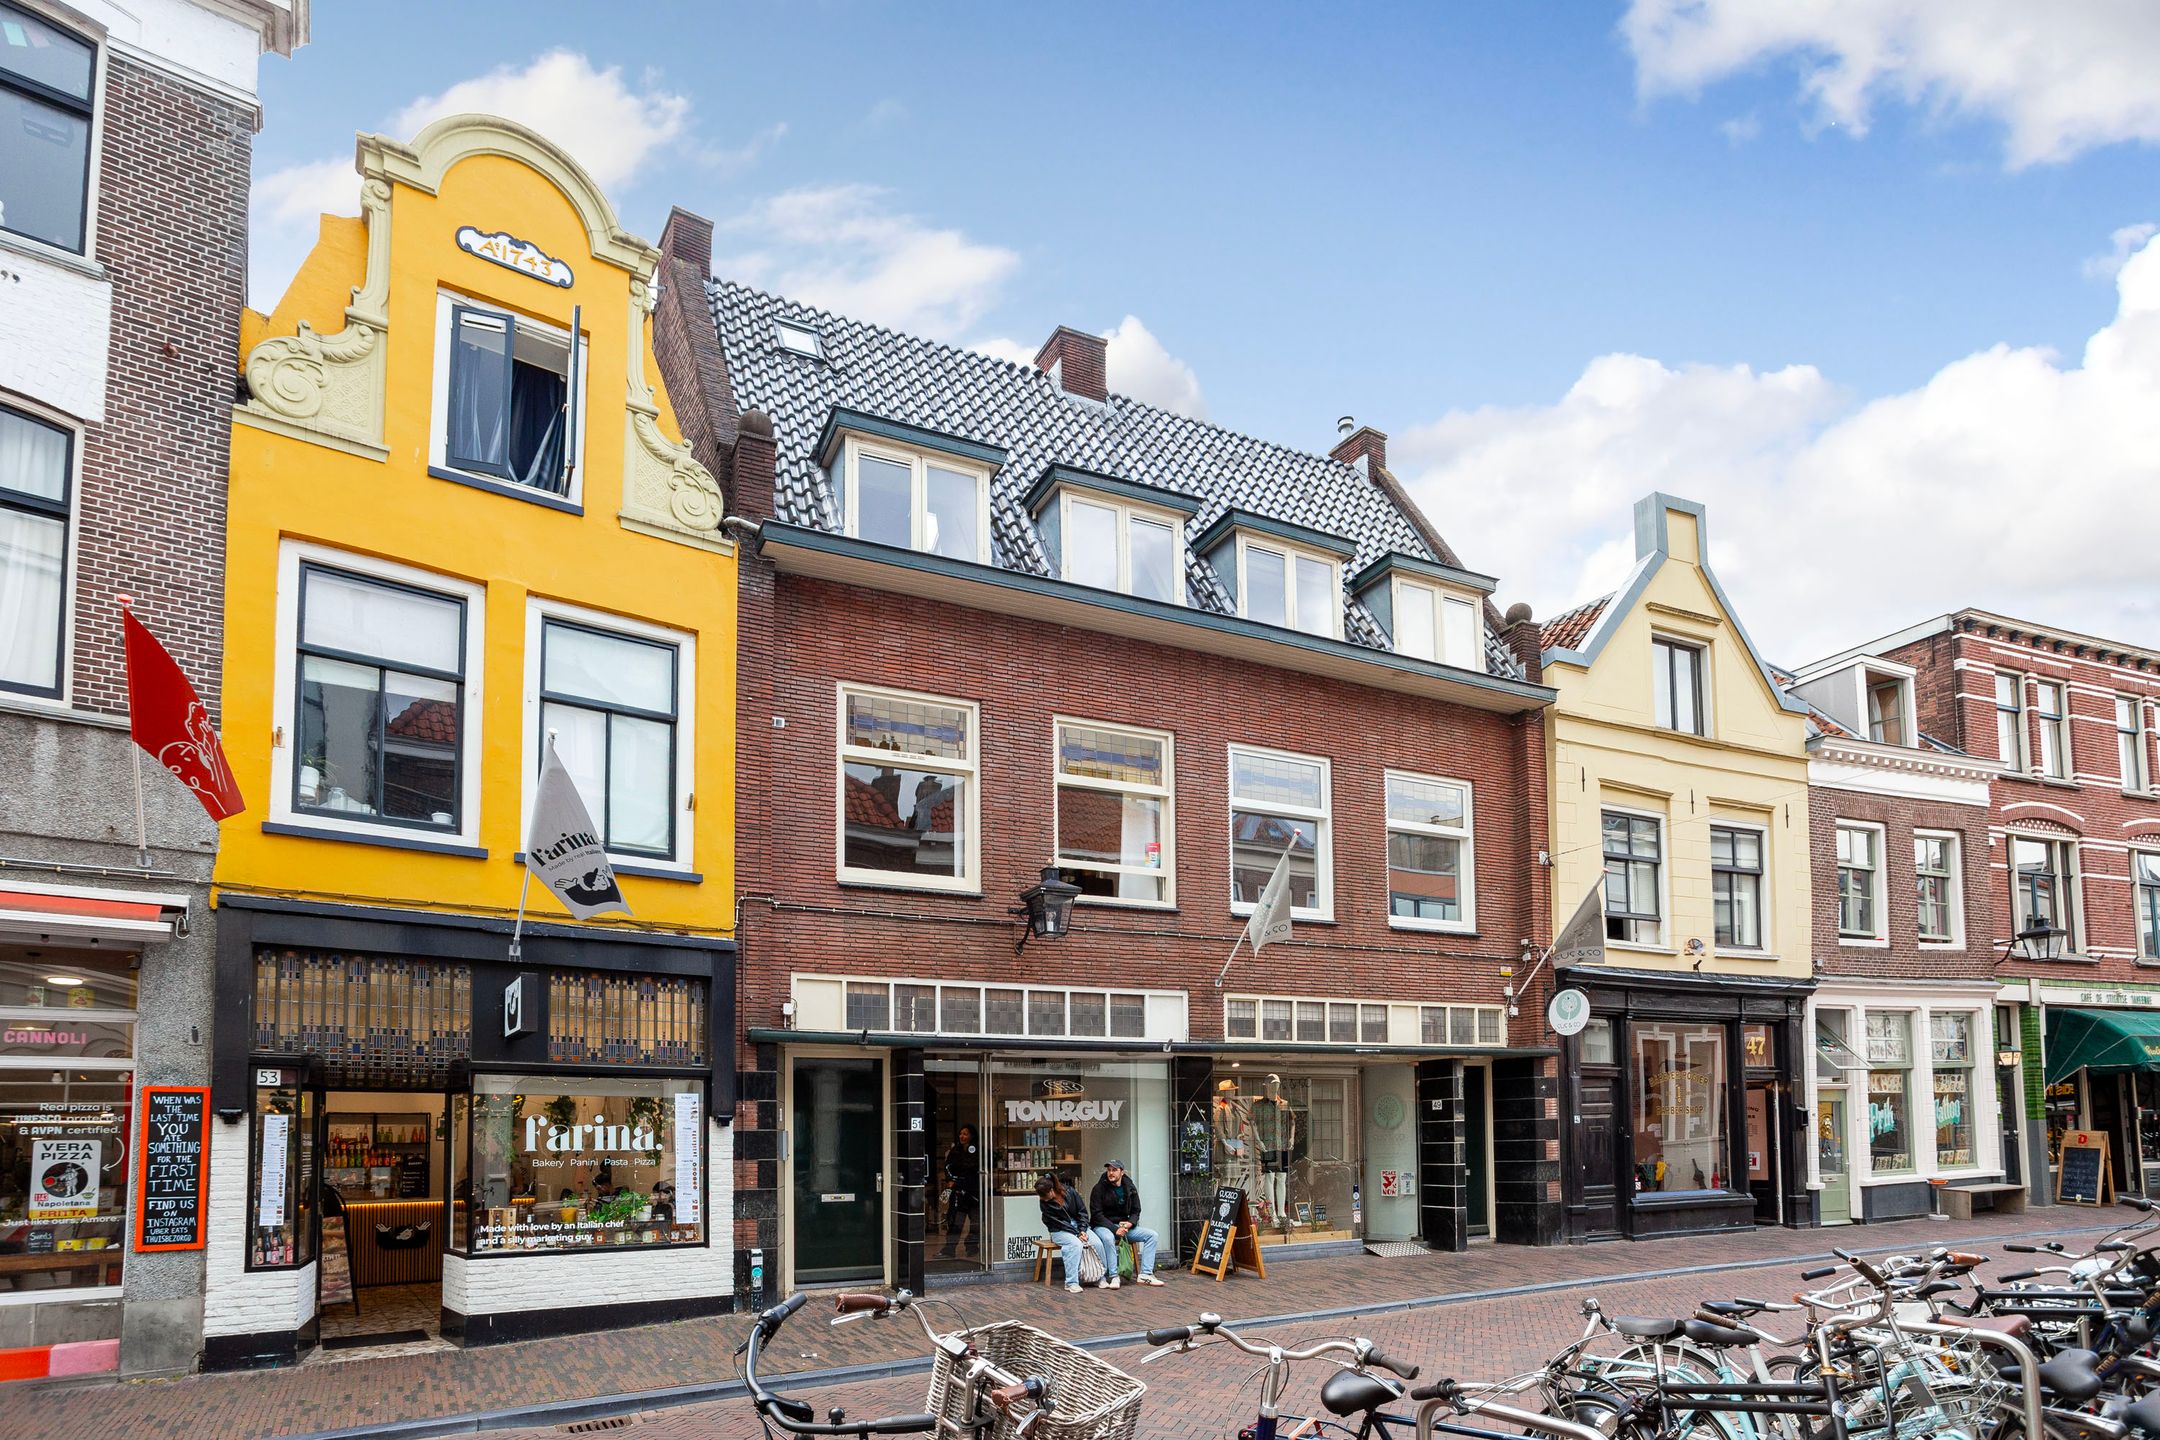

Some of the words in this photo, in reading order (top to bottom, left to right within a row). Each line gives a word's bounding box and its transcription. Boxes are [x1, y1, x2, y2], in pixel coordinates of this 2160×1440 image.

[548, 861, 566, 872] Made
[574, 851, 586, 859] real
[2096, 993, 2102, 1003] DE
[4, 1031, 87, 1044] CANNOLI
[1746, 1036, 1765, 1055] 47
[260, 1071, 278, 1084] 53
[153, 1095, 181, 1104] WHEN
[184, 1096, 202, 1104] WAS
[40, 1103, 67, 1111] Real
[70, 1103, 100, 1113] pizza
[102, 1102, 112, 1111] is
[165, 1105, 183, 1113] THE
[1004, 1100, 1123, 1122] TONI&GUY
[1655, 1105, 1683, 1115] BARBER
[1686, 1105, 1704, 1114] SHOP
[15, 1114, 61, 1123] UNESCO
[66, 1114, 125, 1124] protected
[150, 1114, 173, 1122] LAST
[176, 1113, 199, 1121] TIME
[157, 1123, 189, 1135] YOU
[912, 1119, 921, 1129] 51
[1072, 1121, 1120, 1129] HAIRDRESSING
[19, 1127, 29, 1135] &
[31, 1127, 63, 1135] AVPN
[67, 1125, 121, 1135] certified.
[524, 1114, 664, 1151] farina.
[43, 1143, 93, 1151] VERA
[148, 1142, 201, 1153] SOMETHING
[41, 1152, 92, 1160] PIZZA
[176, 1155, 192, 1163] THE
[532, 1159, 564, 1168] Bakery
[570, 1158, 598, 1166] Panini
[604, 1158, 628, 1166] Pasta
[634, 1157, 656, 1166] Pizza
[150, 1164, 197, 1177] FIRST
[149, 1179, 196, 1192] TIME
[37, 1200, 91, 1208] Napoletana
[149, 1200, 176, 1210] FIND
[180, 1199, 194, 1209] US
[39, 1209, 88, 1218] FRITTA
[3, 1218, 29, 1227] Just
[31, 1217, 50, 1225] like
[52, 1217, 79, 1225] ours.
[80, 1215, 120, 1224] Amore.
[147, 1217, 196, 1228] INSTAGRAM
[480, 1224, 506, 1233] Made
[508, 1223, 529, 1232] with
[530, 1222, 550, 1231] love
[551, 1222, 562, 1232] by
[577, 1220, 603, 1229] Italian
[605, 1220, 625, 1228] chef
[145, 1235, 192, 1243] THUISBEZORGD
[481, 1236, 498, 1245] and
[508, 1235, 524, 1245] silly
[527, 1233, 574, 1244] marketing
[575, 1234, 594, 1243] guy.
[1008, 1244, 1032, 1252] BEAUTY
[1008, 1250, 1036, 1260] CONCEPT
